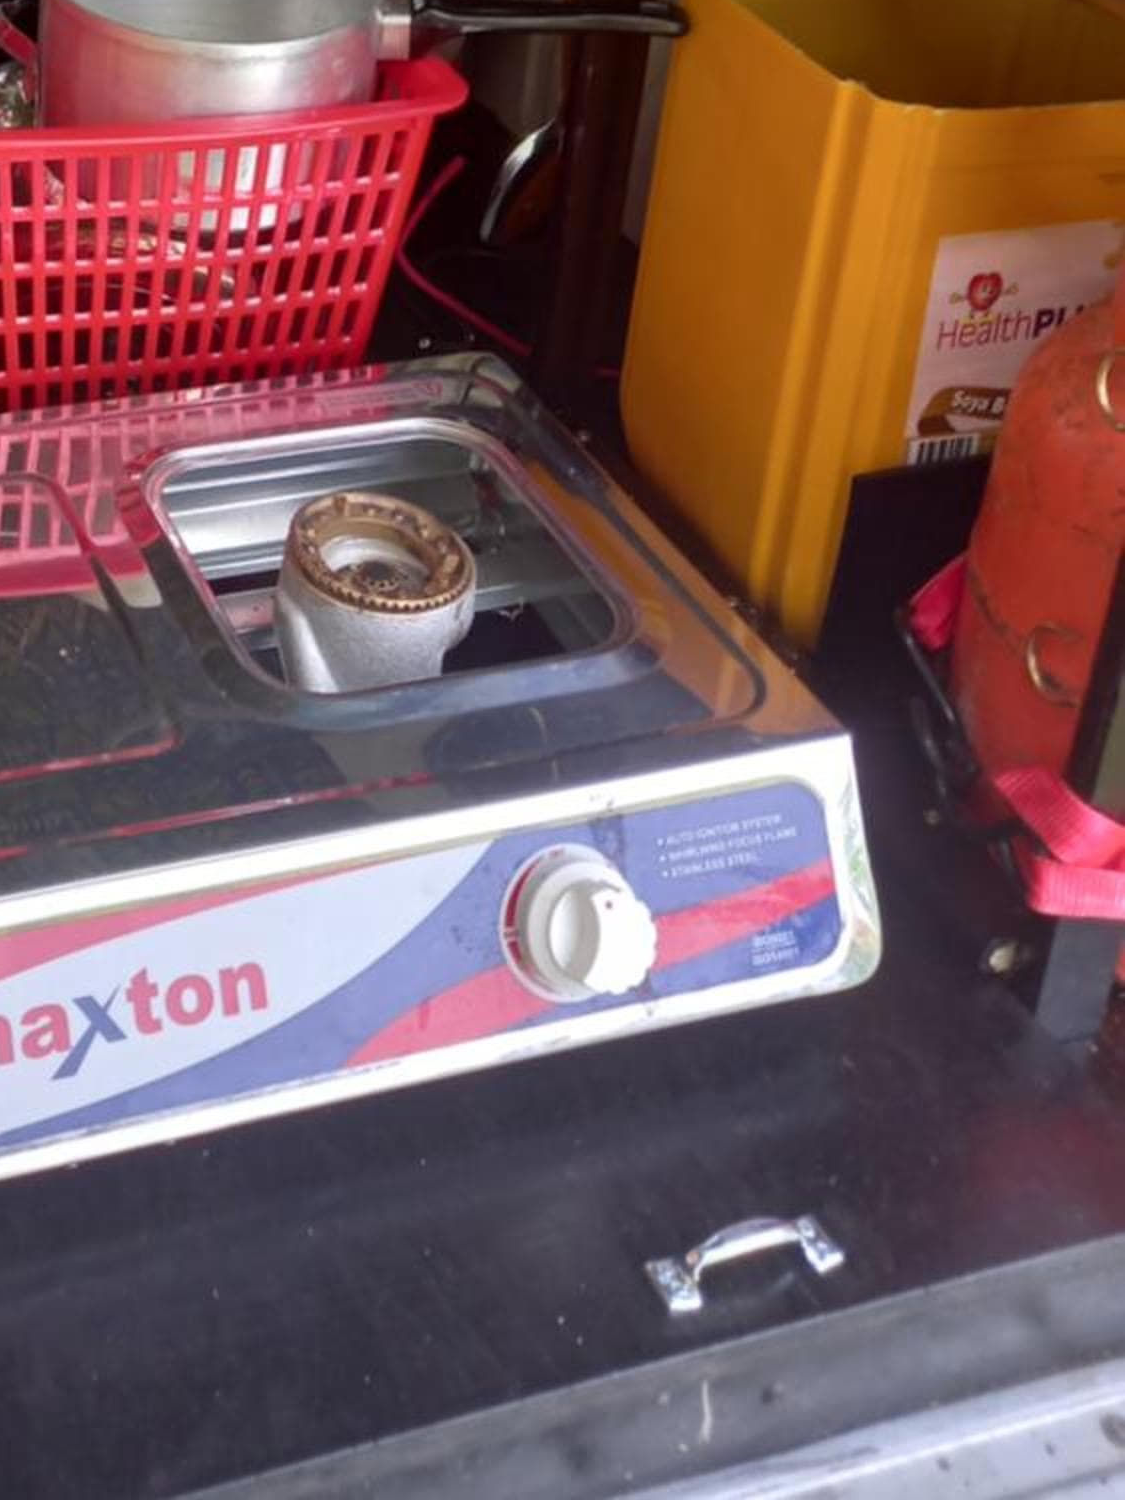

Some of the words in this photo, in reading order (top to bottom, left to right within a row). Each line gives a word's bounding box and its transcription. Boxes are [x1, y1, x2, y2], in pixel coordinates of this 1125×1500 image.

[741, 813, 781, 831] SYSTEM
[763, 826, 797, 843] FLAME
[670, 855, 725, 877] STAINLESS
